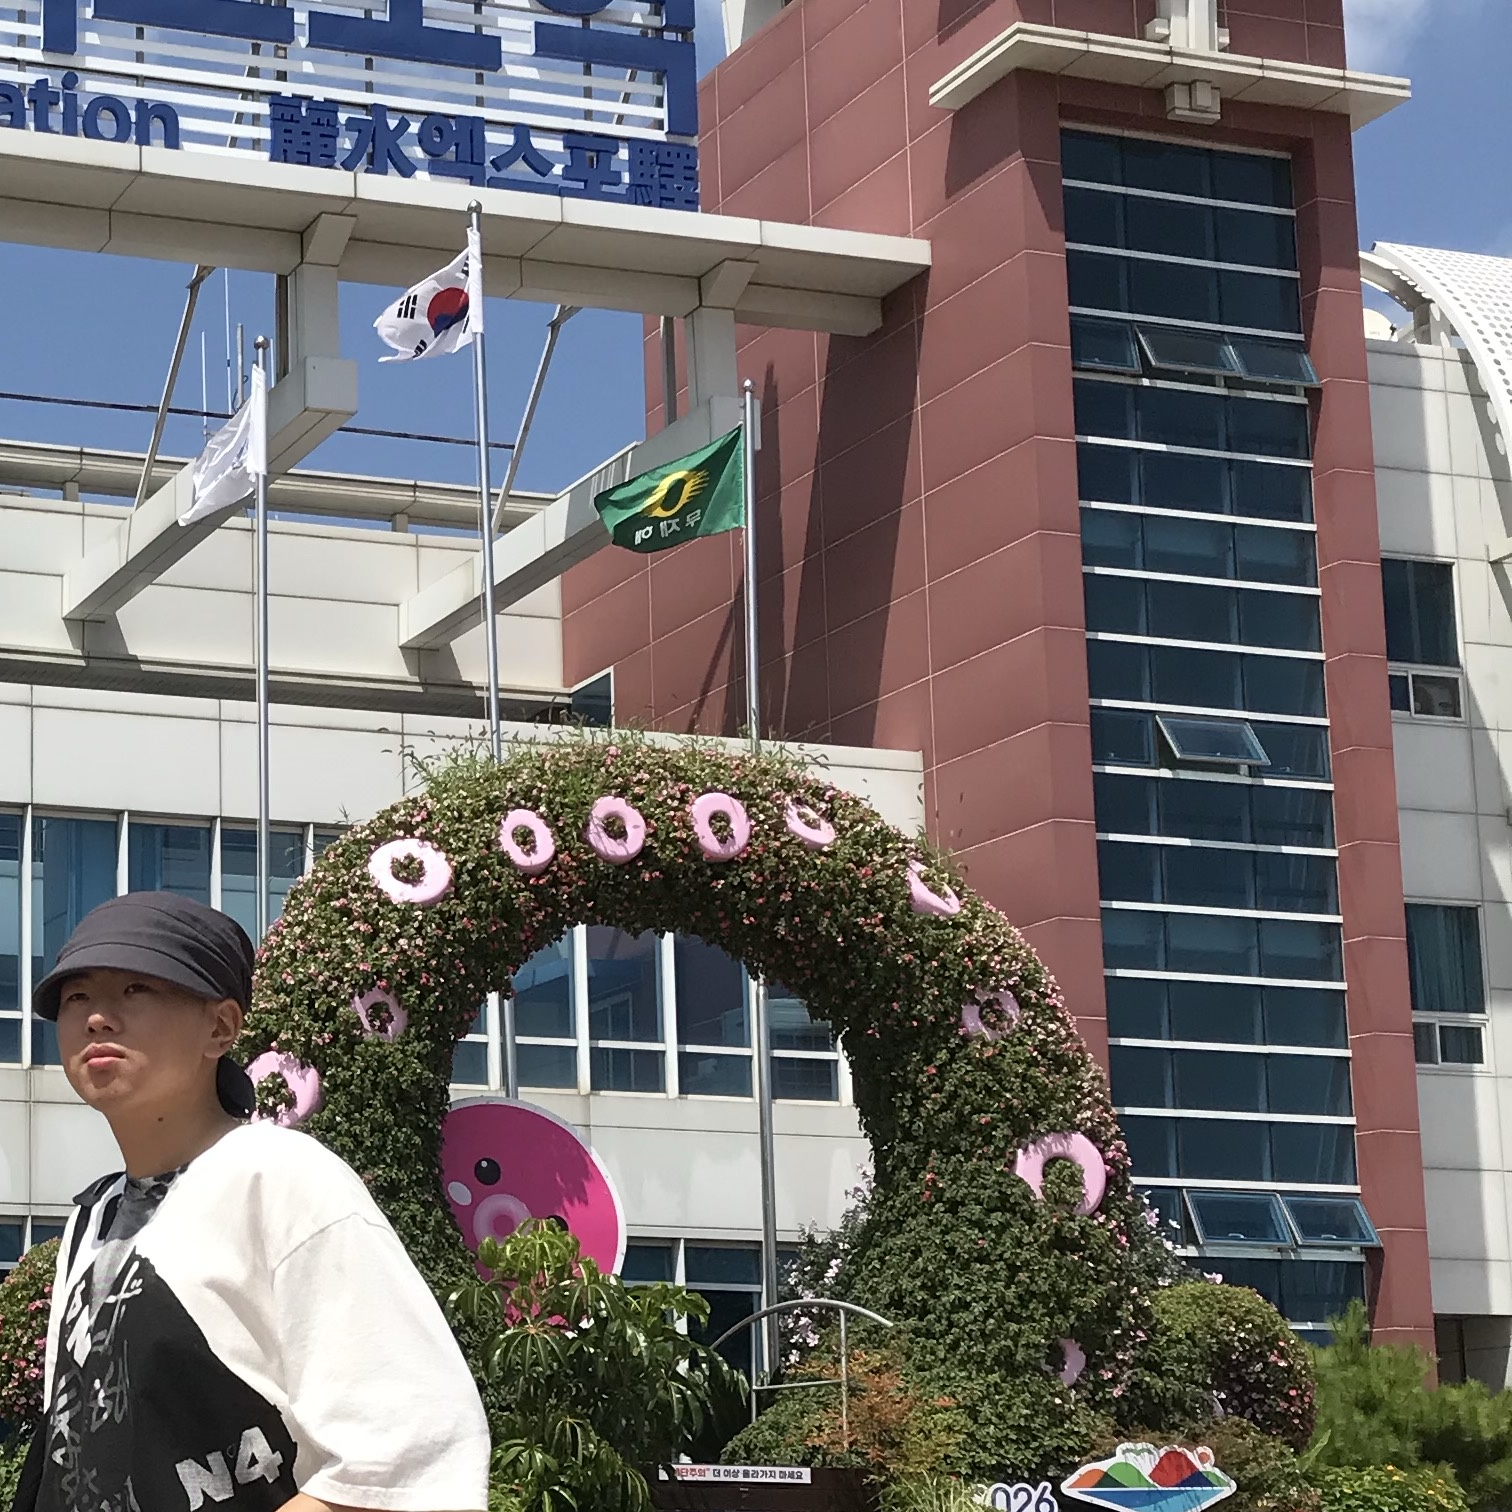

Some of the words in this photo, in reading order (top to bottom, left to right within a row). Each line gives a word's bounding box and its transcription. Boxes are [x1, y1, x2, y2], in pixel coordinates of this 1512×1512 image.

[713, 1469, 721, 1478] 더
[723, 1469, 740, 1479] 이상
[779, 1470, 804, 1480] 마세요
